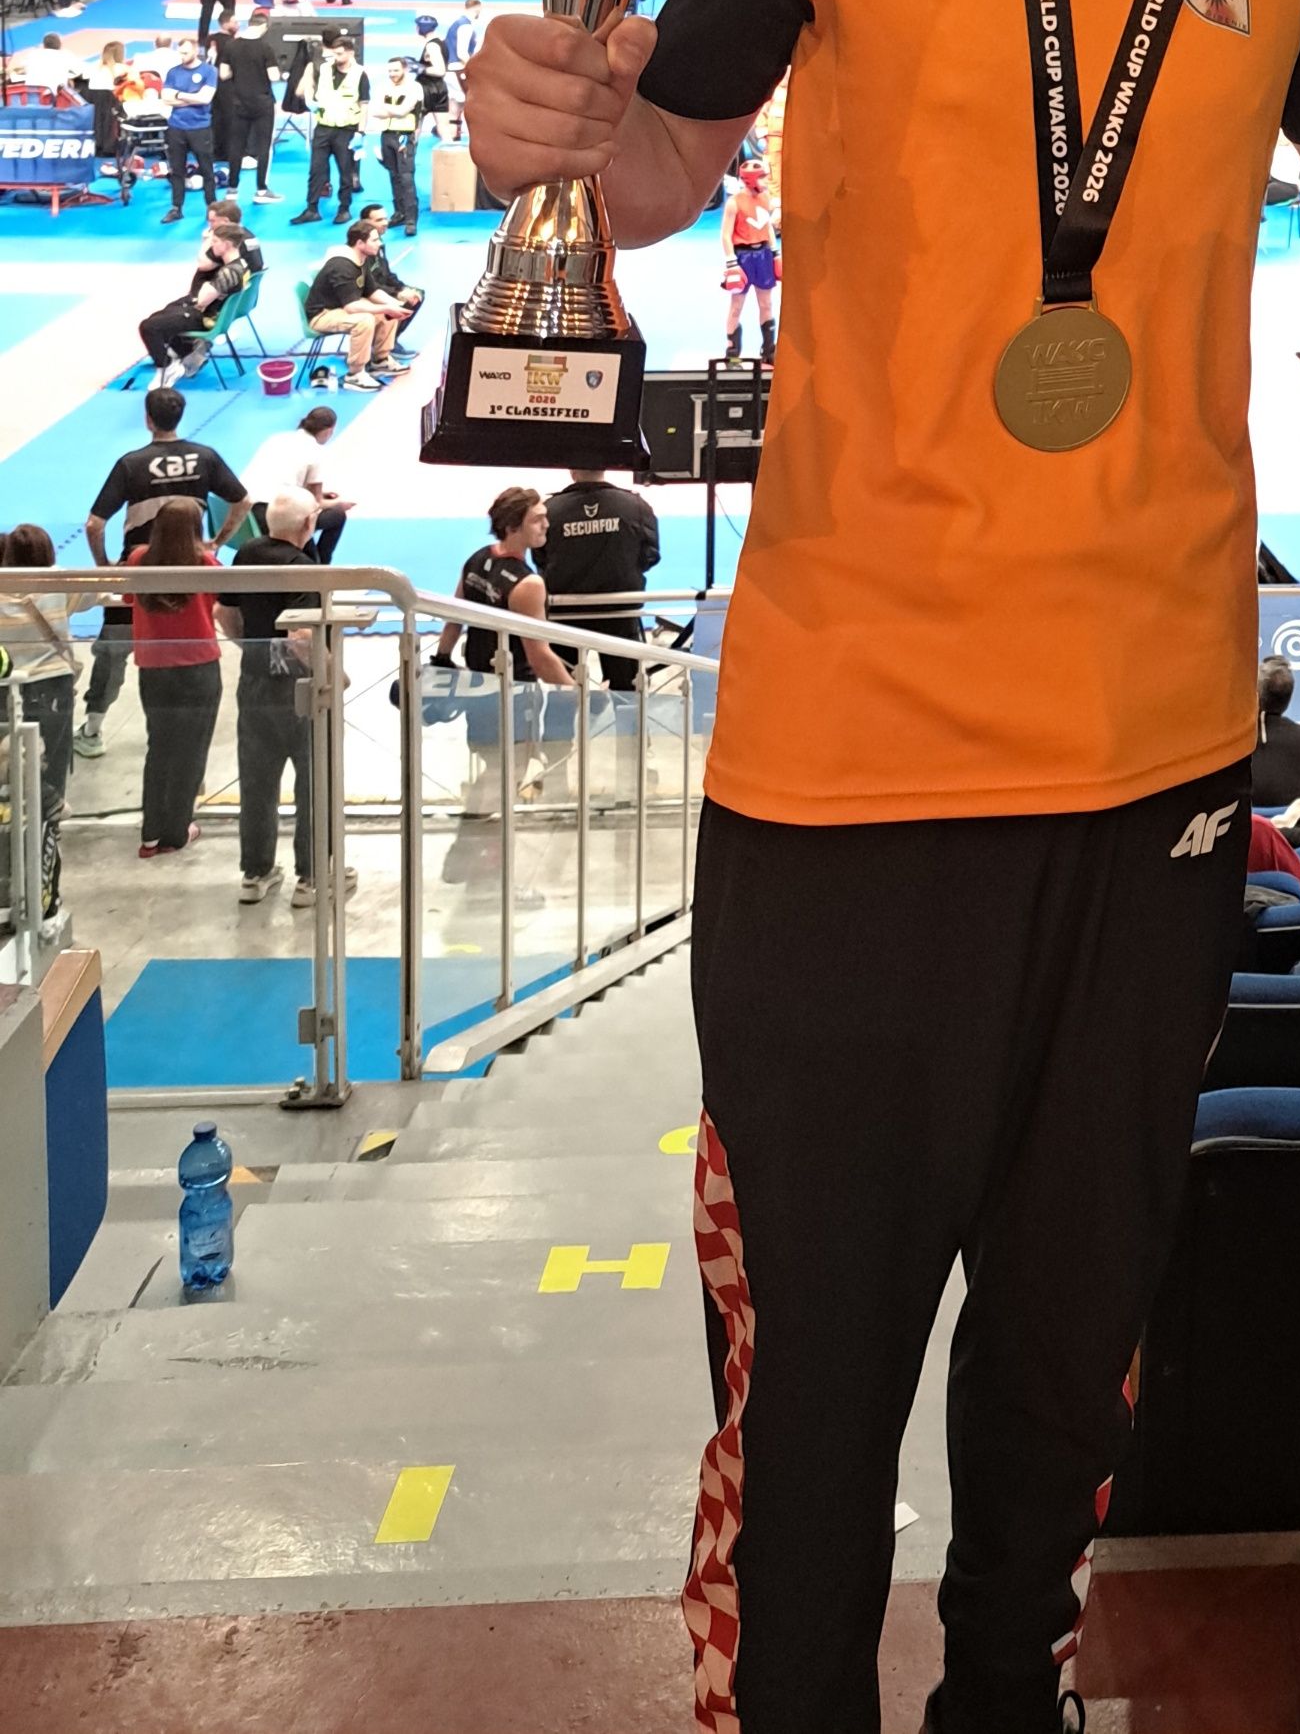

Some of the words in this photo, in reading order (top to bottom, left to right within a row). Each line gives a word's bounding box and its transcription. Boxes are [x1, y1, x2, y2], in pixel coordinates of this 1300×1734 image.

[1044, 35, 1062, 83] CUP
[1125, 34, 1151, 79] CUP
[1047, 85, 1068, 158] WAKO
[1101, 81, 1137, 149] WAKO
[1082, 149, 1113, 204] 2026
[526, 372, 564, 386] IKW
[506, 406, 590, 419] CLASSIFIED
[563, 518, 620, 537] SECURFOX
